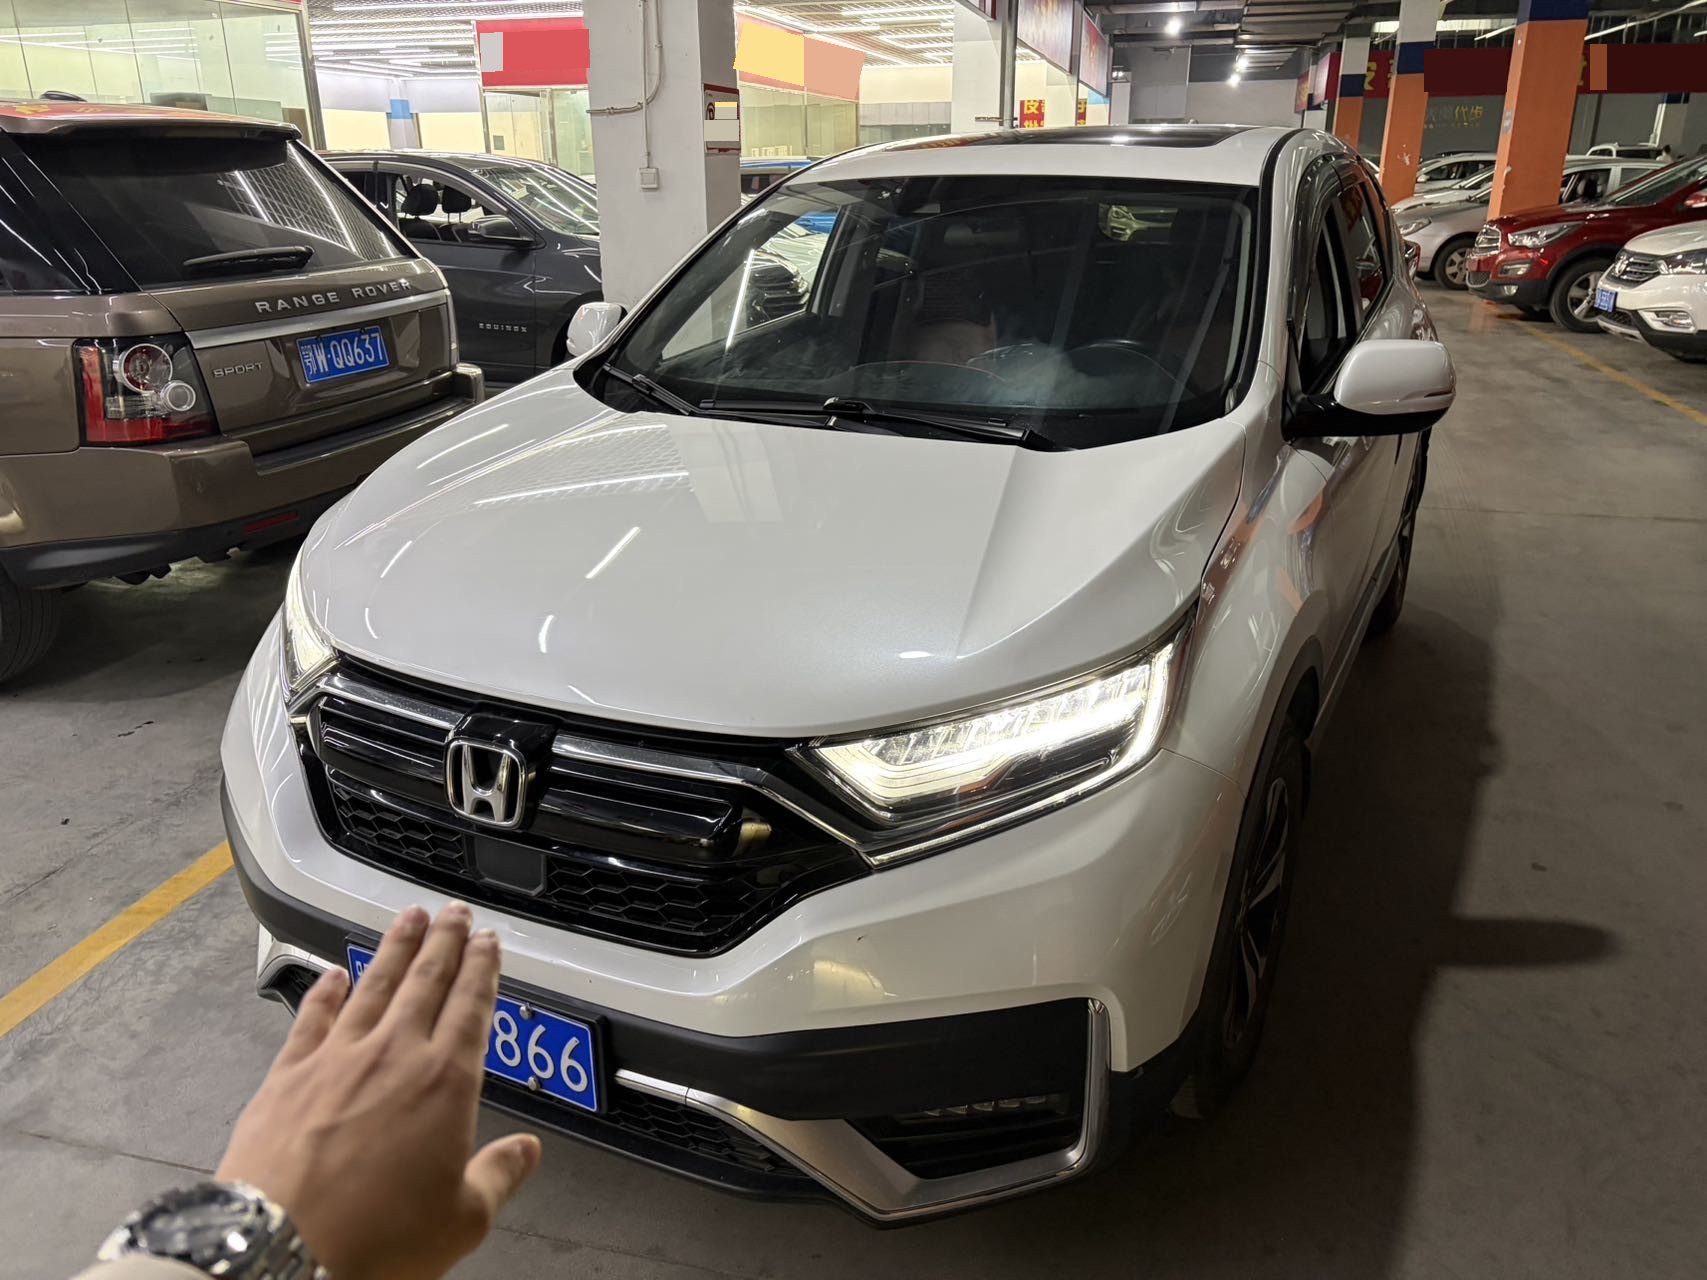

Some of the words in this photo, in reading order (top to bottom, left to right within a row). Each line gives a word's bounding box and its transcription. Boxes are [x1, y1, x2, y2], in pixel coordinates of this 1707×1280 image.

[255, 291, 340, 314] RANGE
[351, 279, 412, 299] ROVER
[213, 361, 263, 378] SPORT
[485, 1010, 588, 1093] 866
